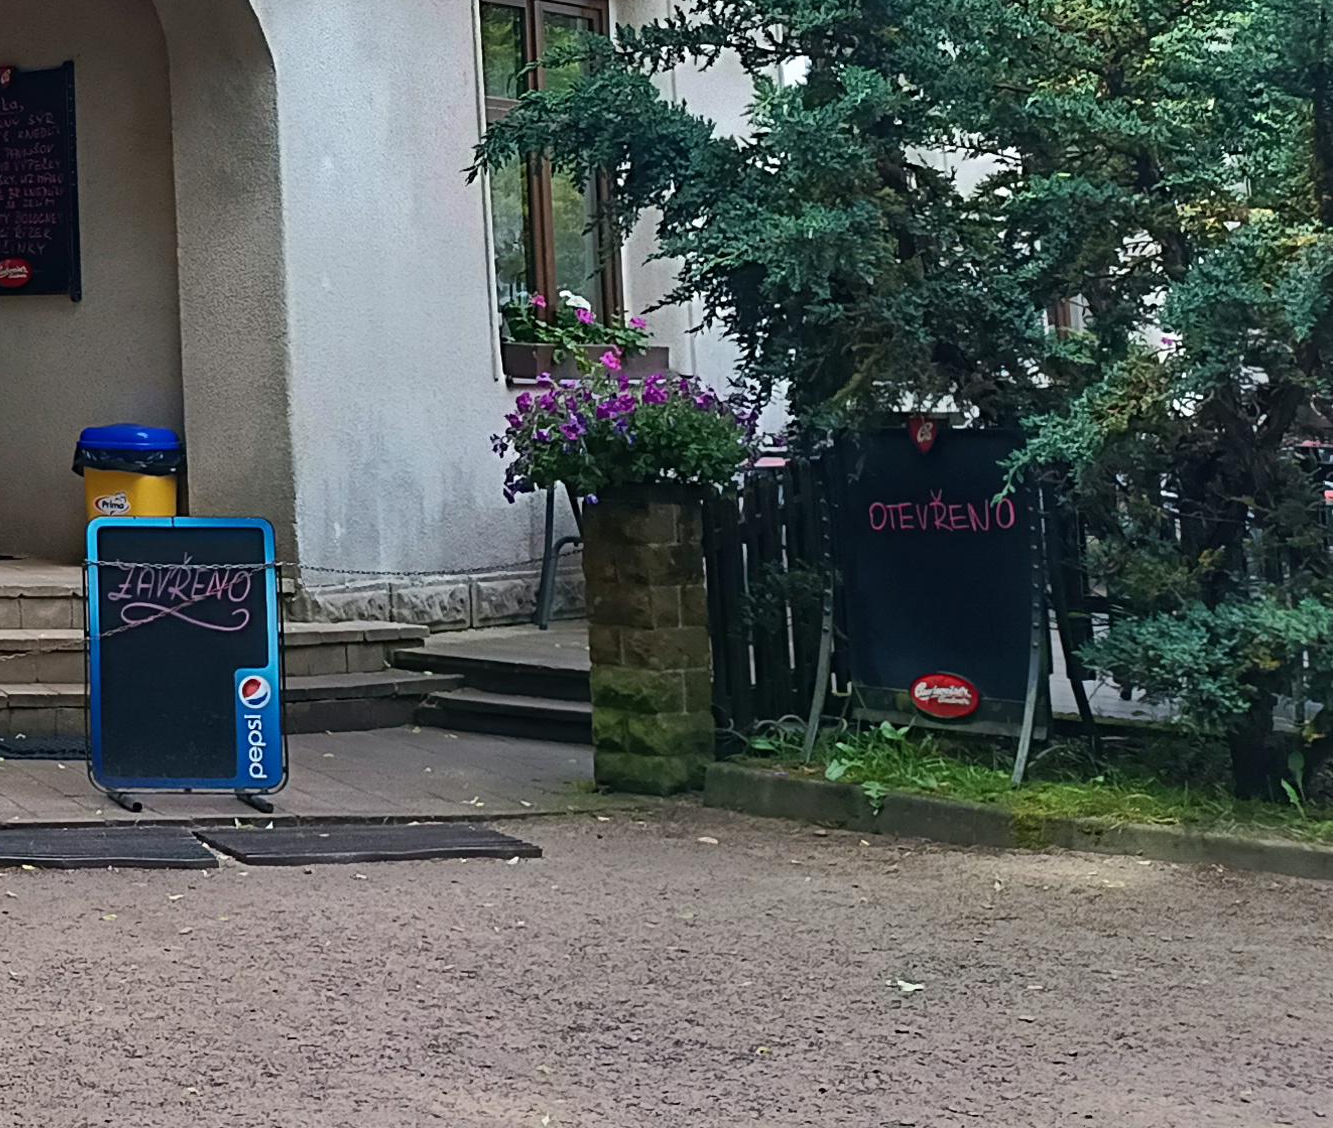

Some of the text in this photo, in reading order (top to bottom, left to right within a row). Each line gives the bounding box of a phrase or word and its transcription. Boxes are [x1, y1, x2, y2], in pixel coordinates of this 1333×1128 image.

[869, 488, 1016, 532] OTEVŘENO
[107, 552, 251, 603] ZAVŘENO
[245, 714, 267, 779] pepsi
